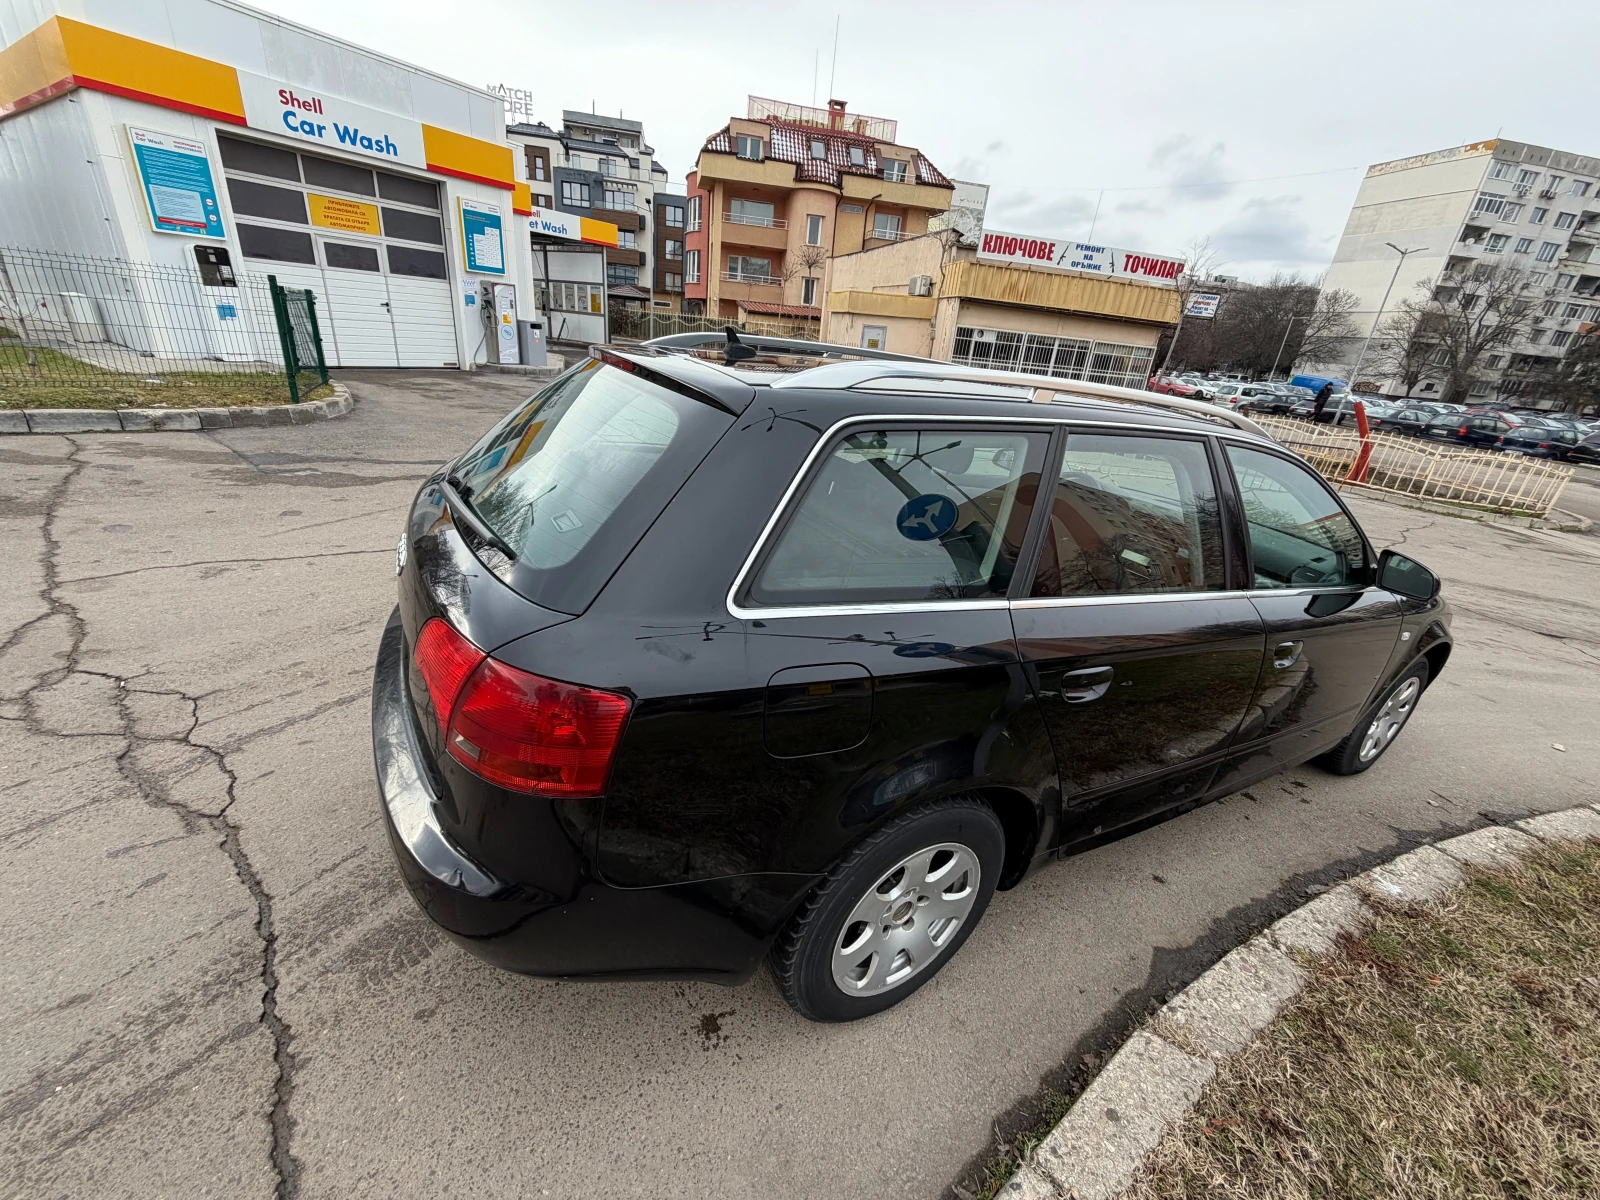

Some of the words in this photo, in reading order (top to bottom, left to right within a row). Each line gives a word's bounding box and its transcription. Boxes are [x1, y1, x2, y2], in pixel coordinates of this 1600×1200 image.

[487, 83, 532, 102] MATCH
[278, 89, 323, 115] Shell
[503, 100, 533, 116] ORE
[282, 110, 326, 138] Car
[333, 122, 398, 156] Wash
[529, 220, 539, 229] et
[541, 220, 568, 235] Wash
[982, 233, 1056, 262] КЛЮЧОВЕ
[1075, 243, 1106, 254] РЕМОНТ
[1083, 253, 1094, 261] НА
[1071, 261, 1102, 271] ОРЪЖИЕ
[1123, 254, 1185, 280] ТОЧИЛАР
